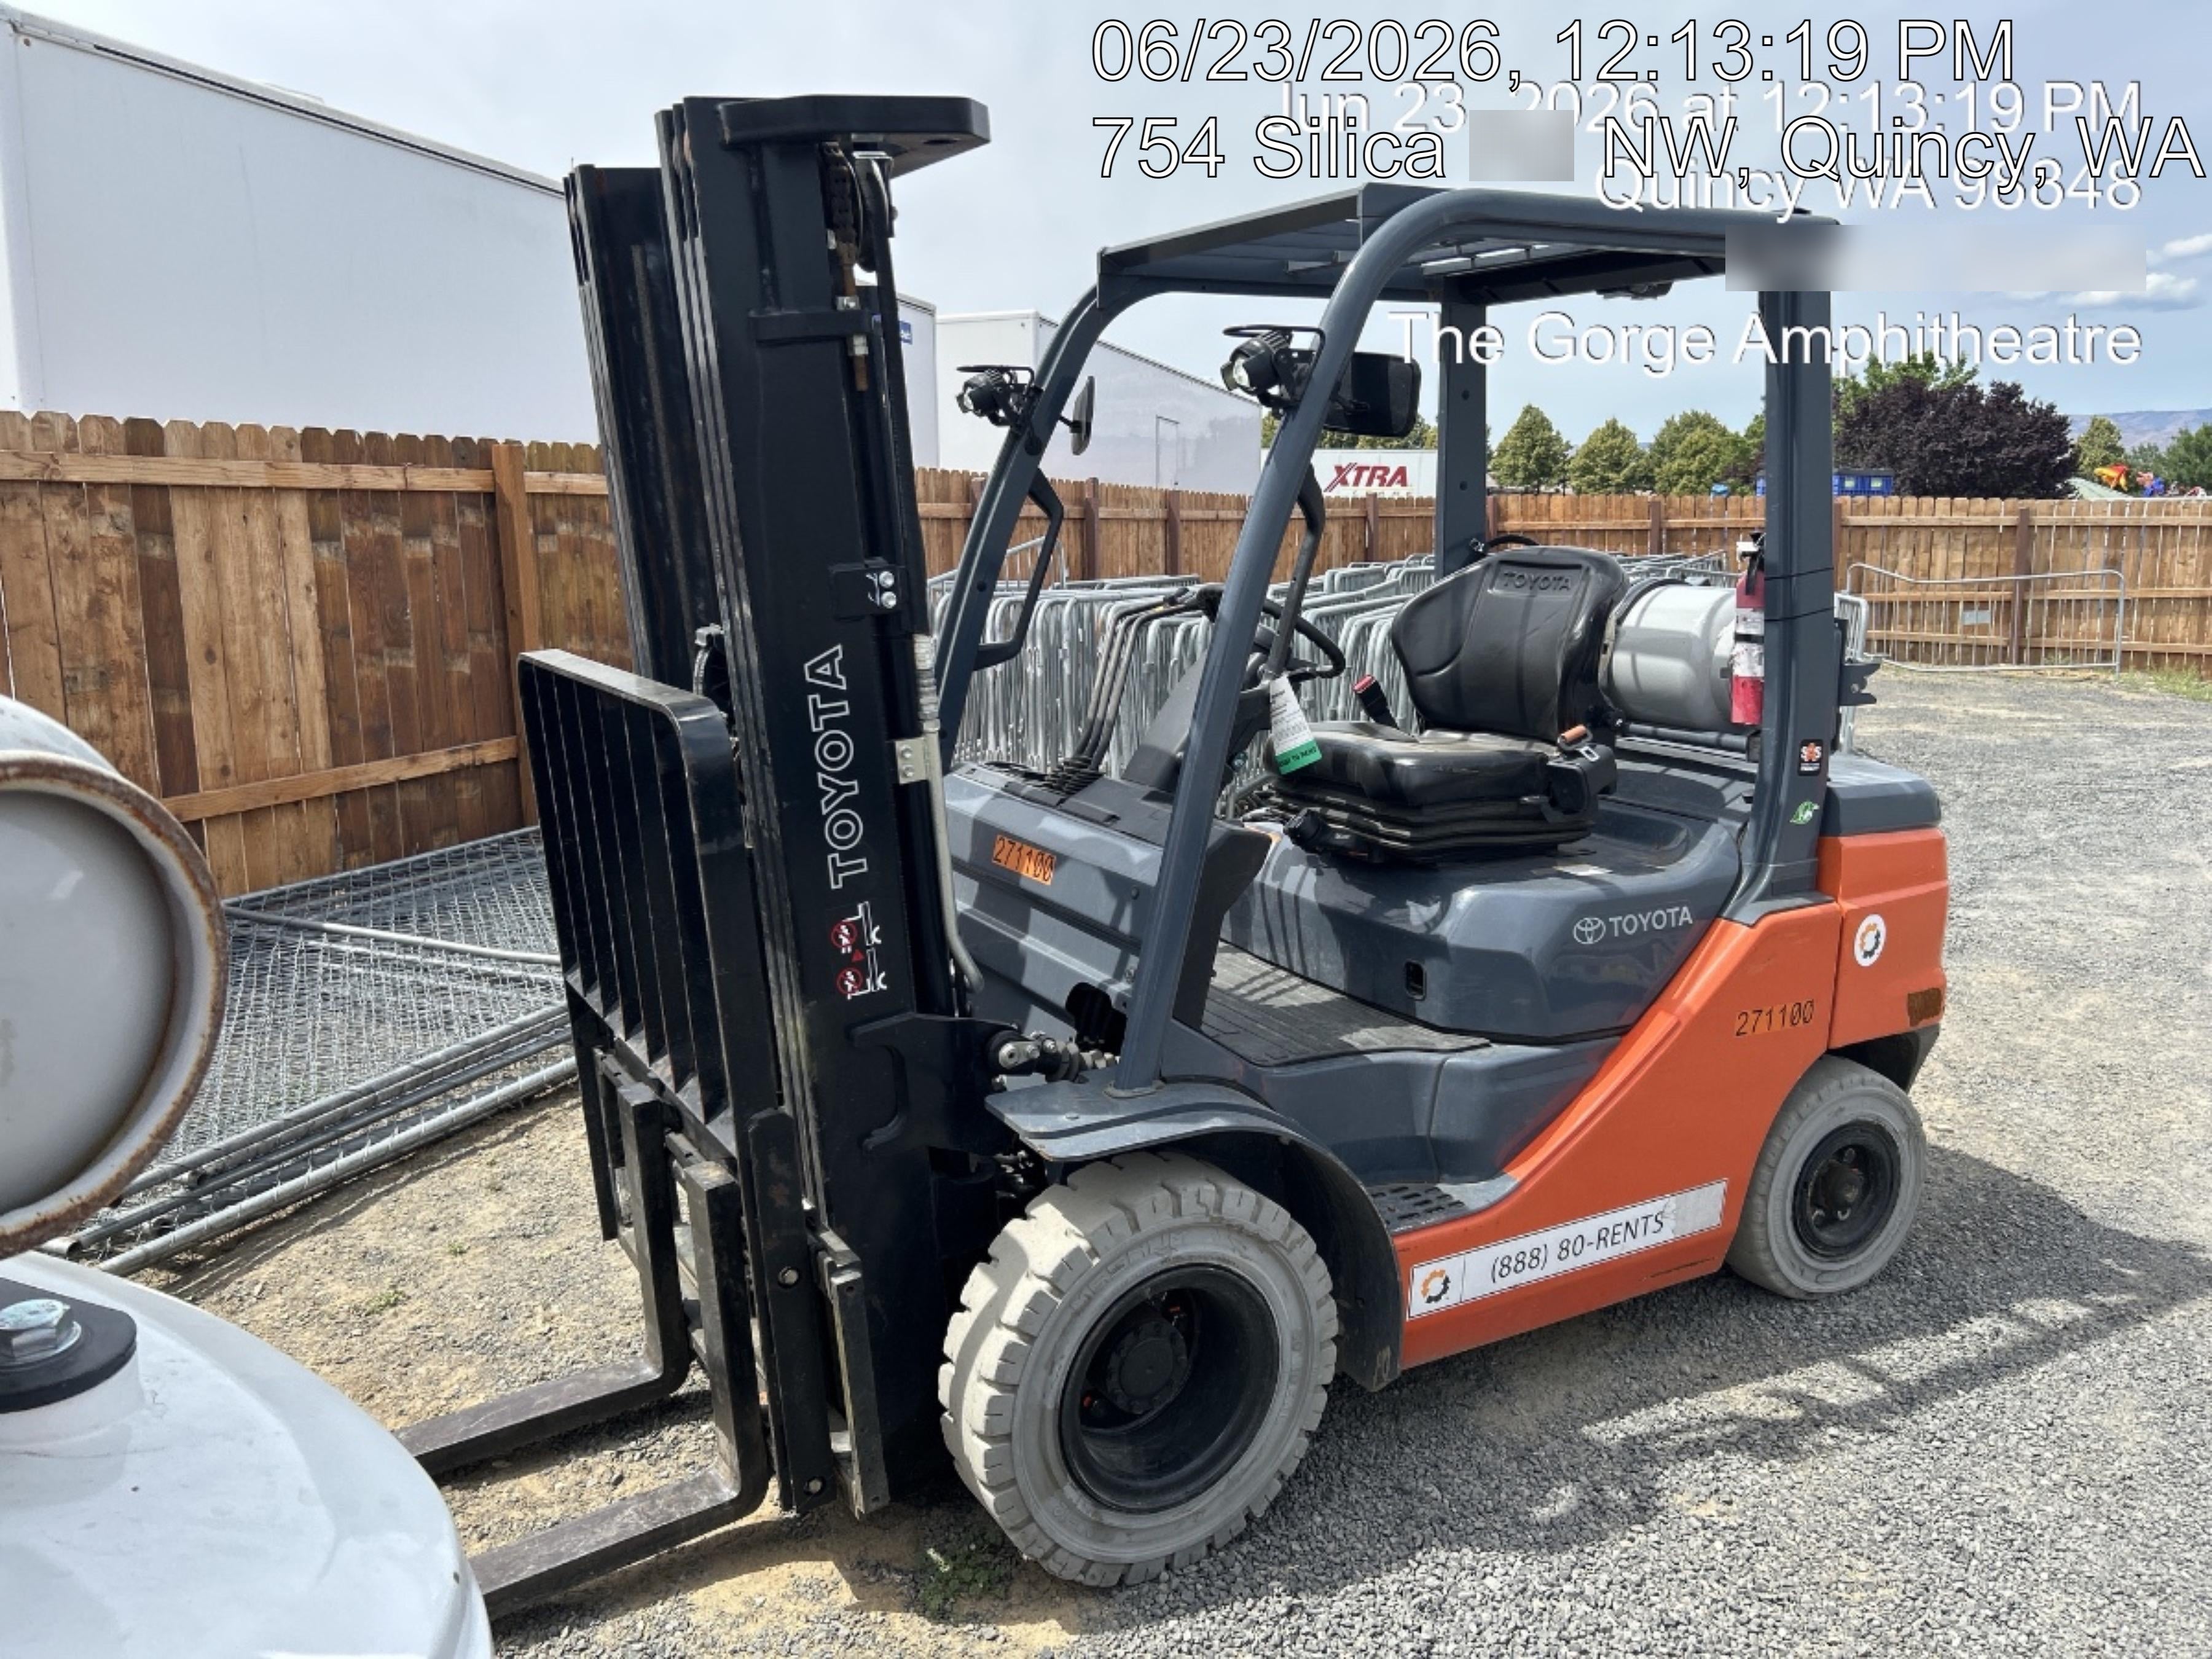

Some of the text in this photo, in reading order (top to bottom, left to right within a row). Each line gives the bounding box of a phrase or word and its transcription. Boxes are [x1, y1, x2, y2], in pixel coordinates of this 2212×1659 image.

[1324, 462, 1408, 492] XTRA
[1504, 572, 1571, 590] TOYOTA
[804, 643, 868, 889] TOYOTA
[993, 836, 1054, 881] 271100
[1609, 906, 1693, 938] TOYOTA
[1735, 1000, 1814, 1037] 271100
[1490, 1211, 1665, 1284] (888) 80-RENTS
